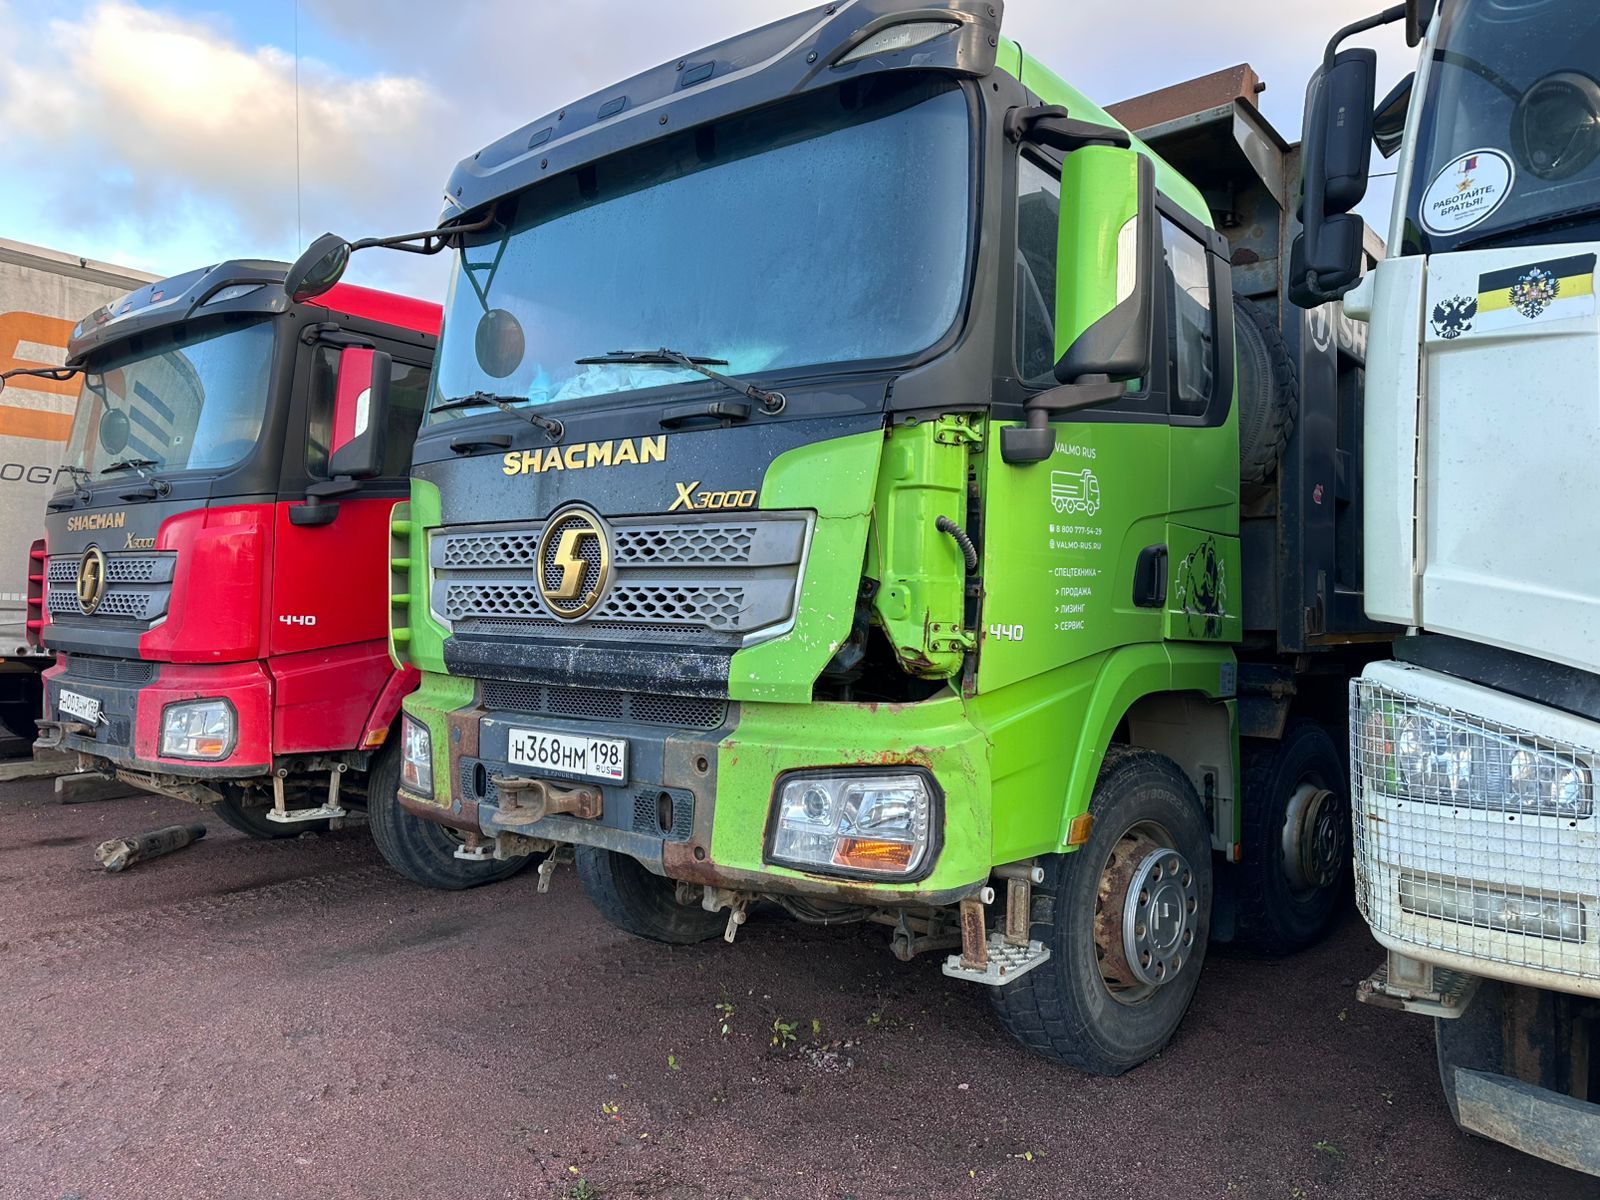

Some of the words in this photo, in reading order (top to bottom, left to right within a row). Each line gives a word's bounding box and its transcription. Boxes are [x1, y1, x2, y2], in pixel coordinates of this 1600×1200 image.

[1433, 185, 1495, 210] РАБОТАЙТЕ,
[1441, 198, 1483, 216] БРАТЬЯ!
[502, 434, 667, 477] SHACMAN
[1055, 442, 1081, 456] VALMO
[1082, 446, 1096, 459] RUS
[668, 481, 757, 511] X3000
[67, 511, 126, 532] SHACMAN
[1062, 525, 1074, 534] 800
[1075, 526, 1102, 536] 777-54-29
[1056, 541, 1102, 550] VALMO-RUS.RU
[1054, 567, 1097, 578] СПЕЦТЕХНИКА
[1061, 587, 1092, 598] ПРОДАЖА
[1060, 604, 1085, 614] ЛИЗИНГ
[279, 615, 316, 626] 440
[1060, 621, 1085, 631] СЕРВИС
[990, 623, 1024, 641] 440
[514, 735, 586, 769] Н368НМ
[590, 742, 619, 765] 198
[595, 765, 611, 774] RUS
